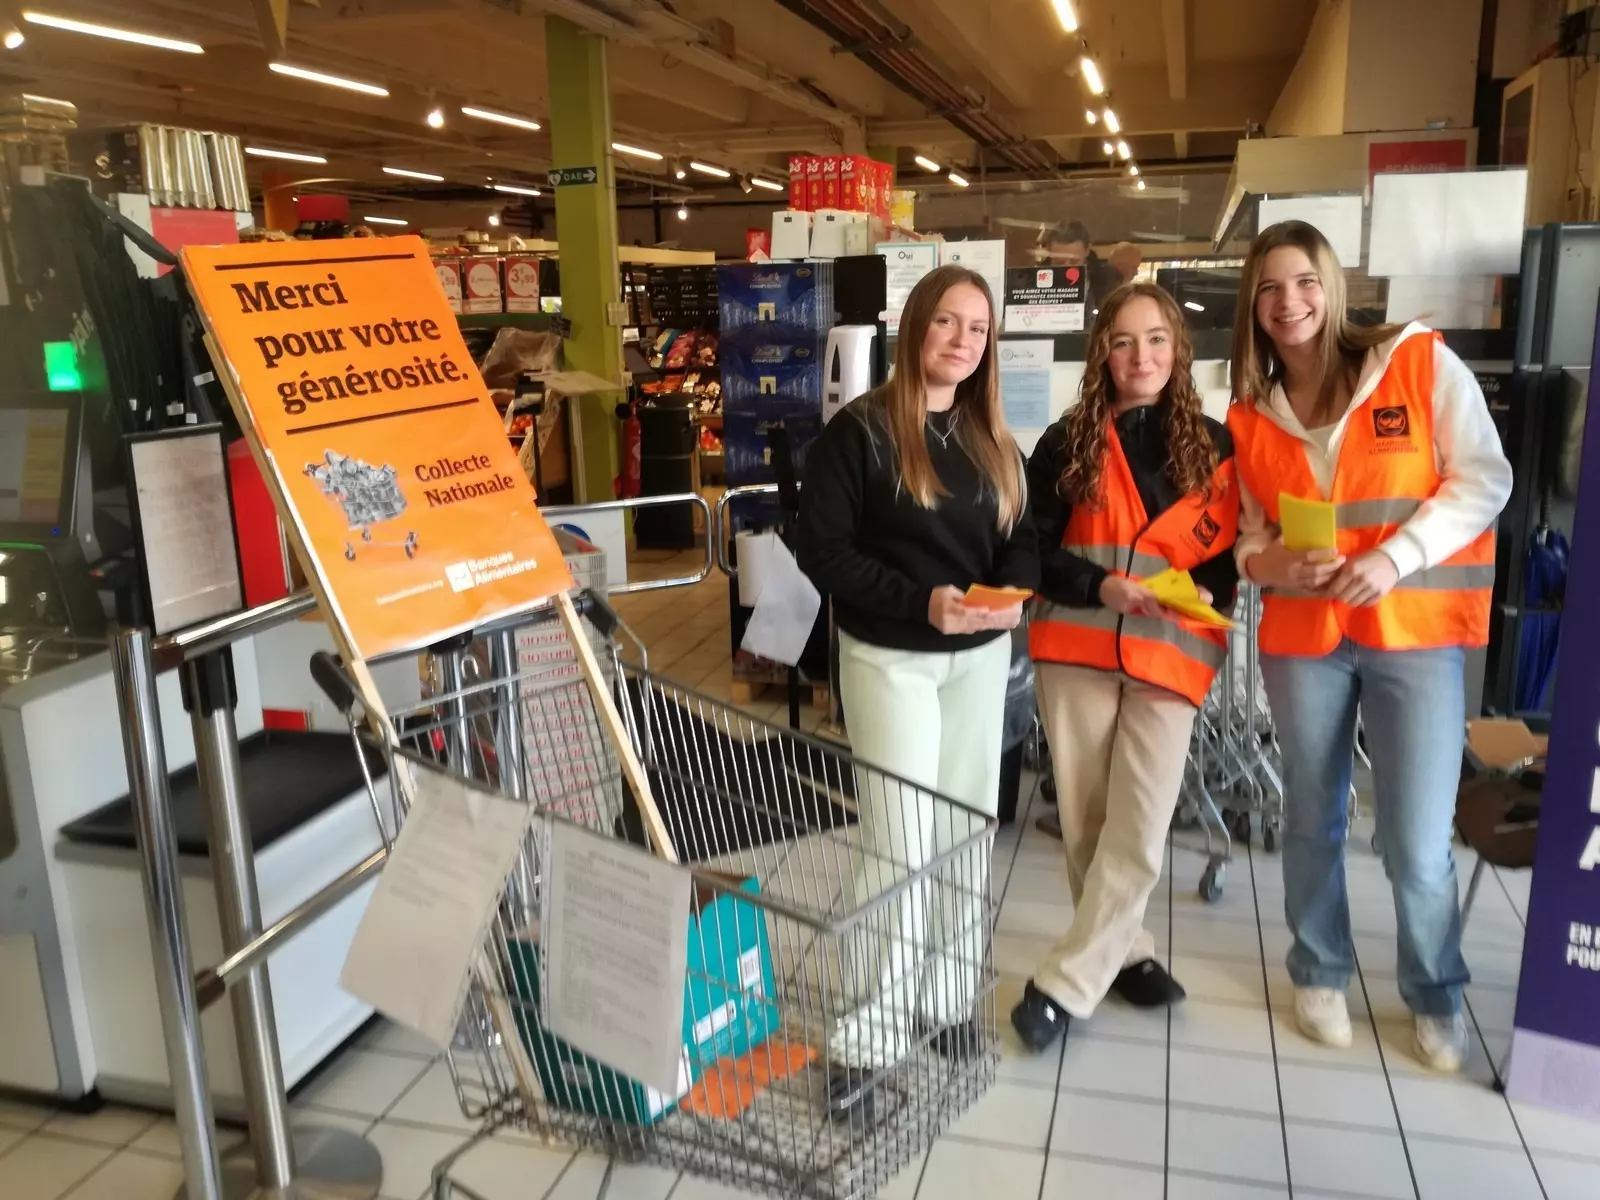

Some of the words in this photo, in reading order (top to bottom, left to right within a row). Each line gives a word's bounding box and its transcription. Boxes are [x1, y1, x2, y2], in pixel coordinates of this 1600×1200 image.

[897, 250, 914, 261] Oui
[230, 273, 349, 315] Merci
[254, 327, 347, 368] pour
[349, 317, 442, 350] votre
[276, 352, 470, 416] générosité.
[414, 451, 492, 483] Collecte
[423, 472, 515, 508] Nationale
[468, 551, 515, 572] Banques
[474, 558, 538, 587] Alimentaires
[1569, 921, 1591, 946] EN
